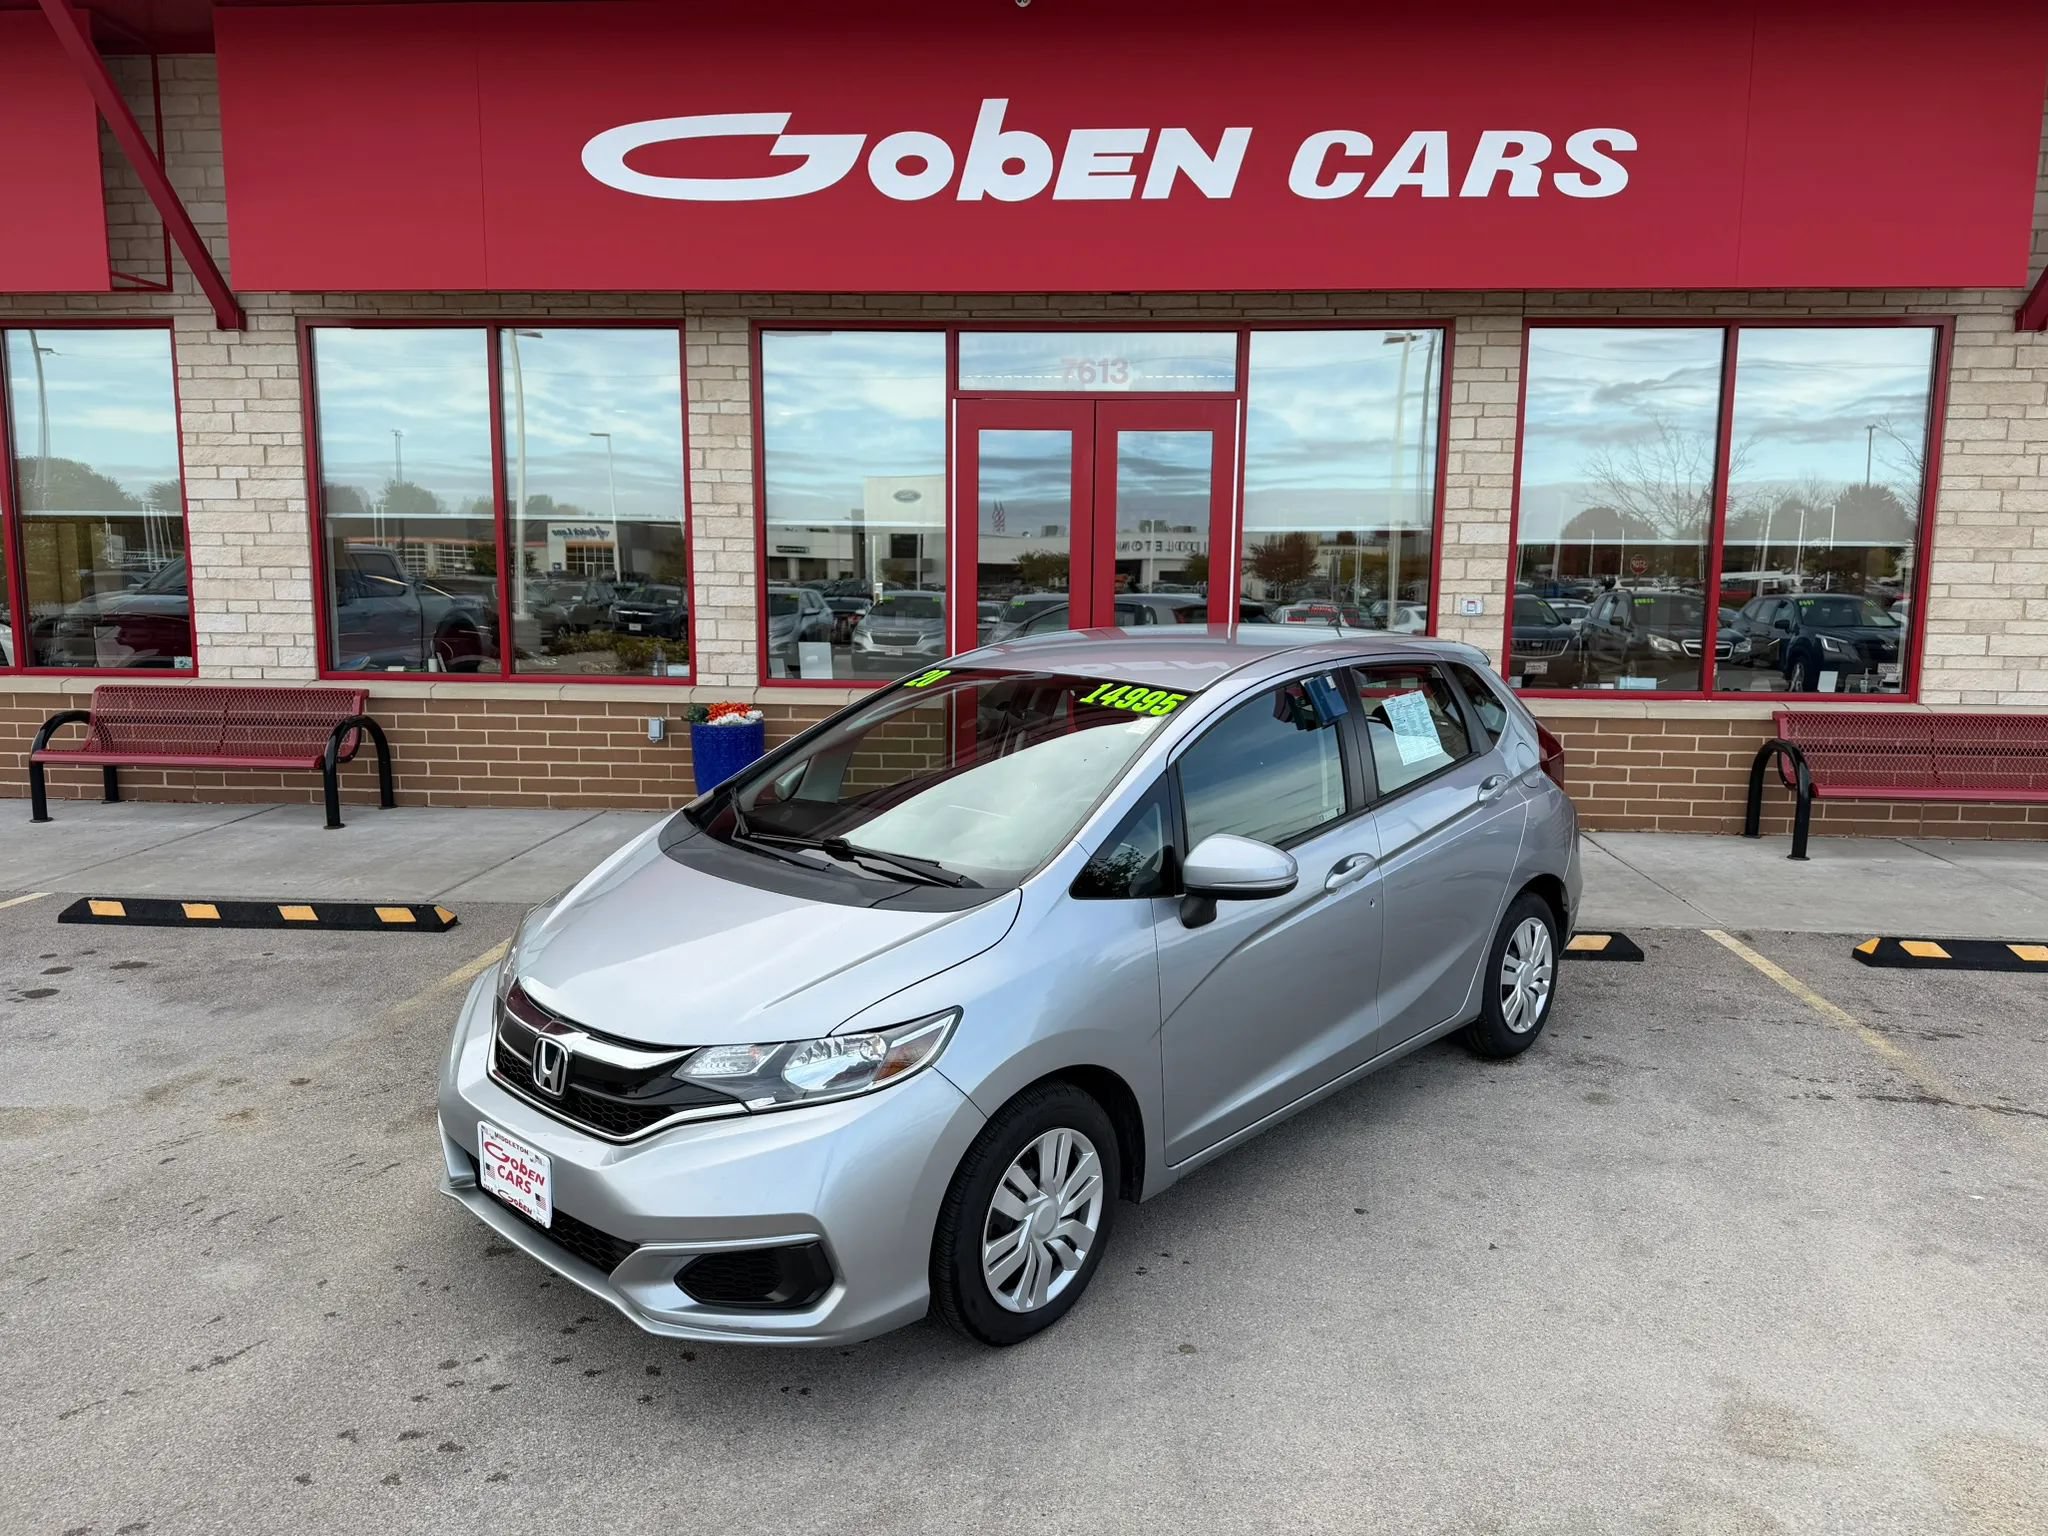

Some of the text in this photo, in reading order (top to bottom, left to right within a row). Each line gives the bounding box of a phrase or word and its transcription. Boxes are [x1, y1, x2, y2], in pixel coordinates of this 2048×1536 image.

[1288, 128, 1638, 199] CARS
[1061, 358, 1129, 384] 7613
[903, 669, 951, 688] 20
[1079, 683, 1187, 716] 14995
[494, 1131, 529, 1156] MIDDLETON
[497, 1164, 532, 1195] CARS
